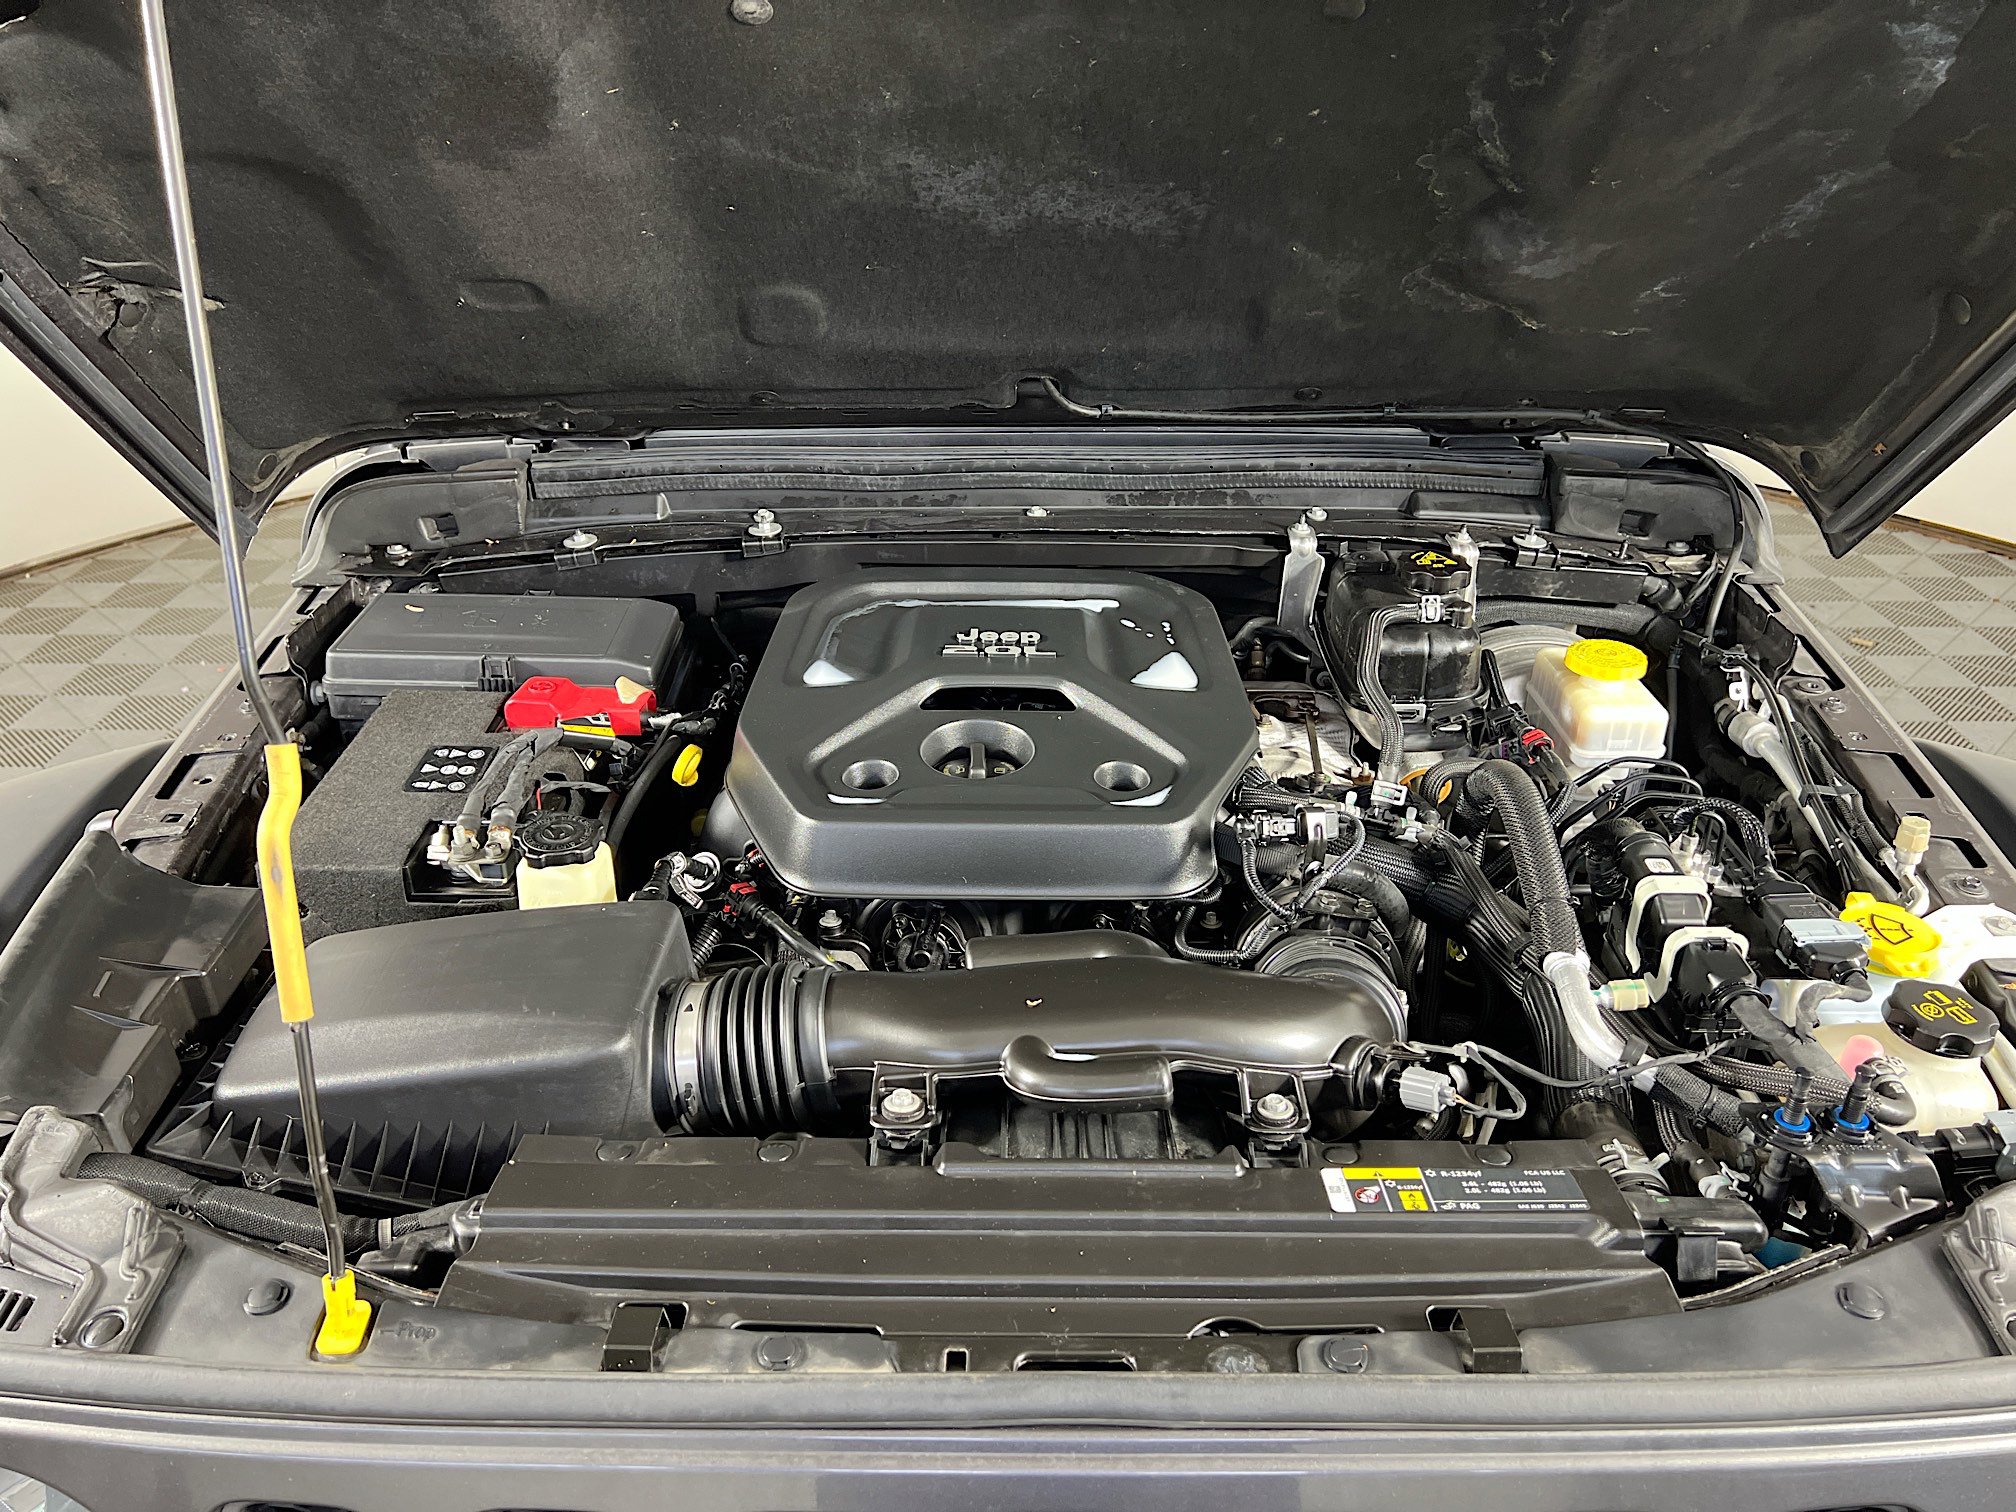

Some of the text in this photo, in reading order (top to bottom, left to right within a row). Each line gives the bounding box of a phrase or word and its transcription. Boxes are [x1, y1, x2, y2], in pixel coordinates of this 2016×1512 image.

[956, 628, 1041, 644] Jeep
[942, 645, 1057, 658] 2.0L
[1440, 1170, 1482, 1178] R-1234yf
[1459, 1202, 1481, 1210] PAG
